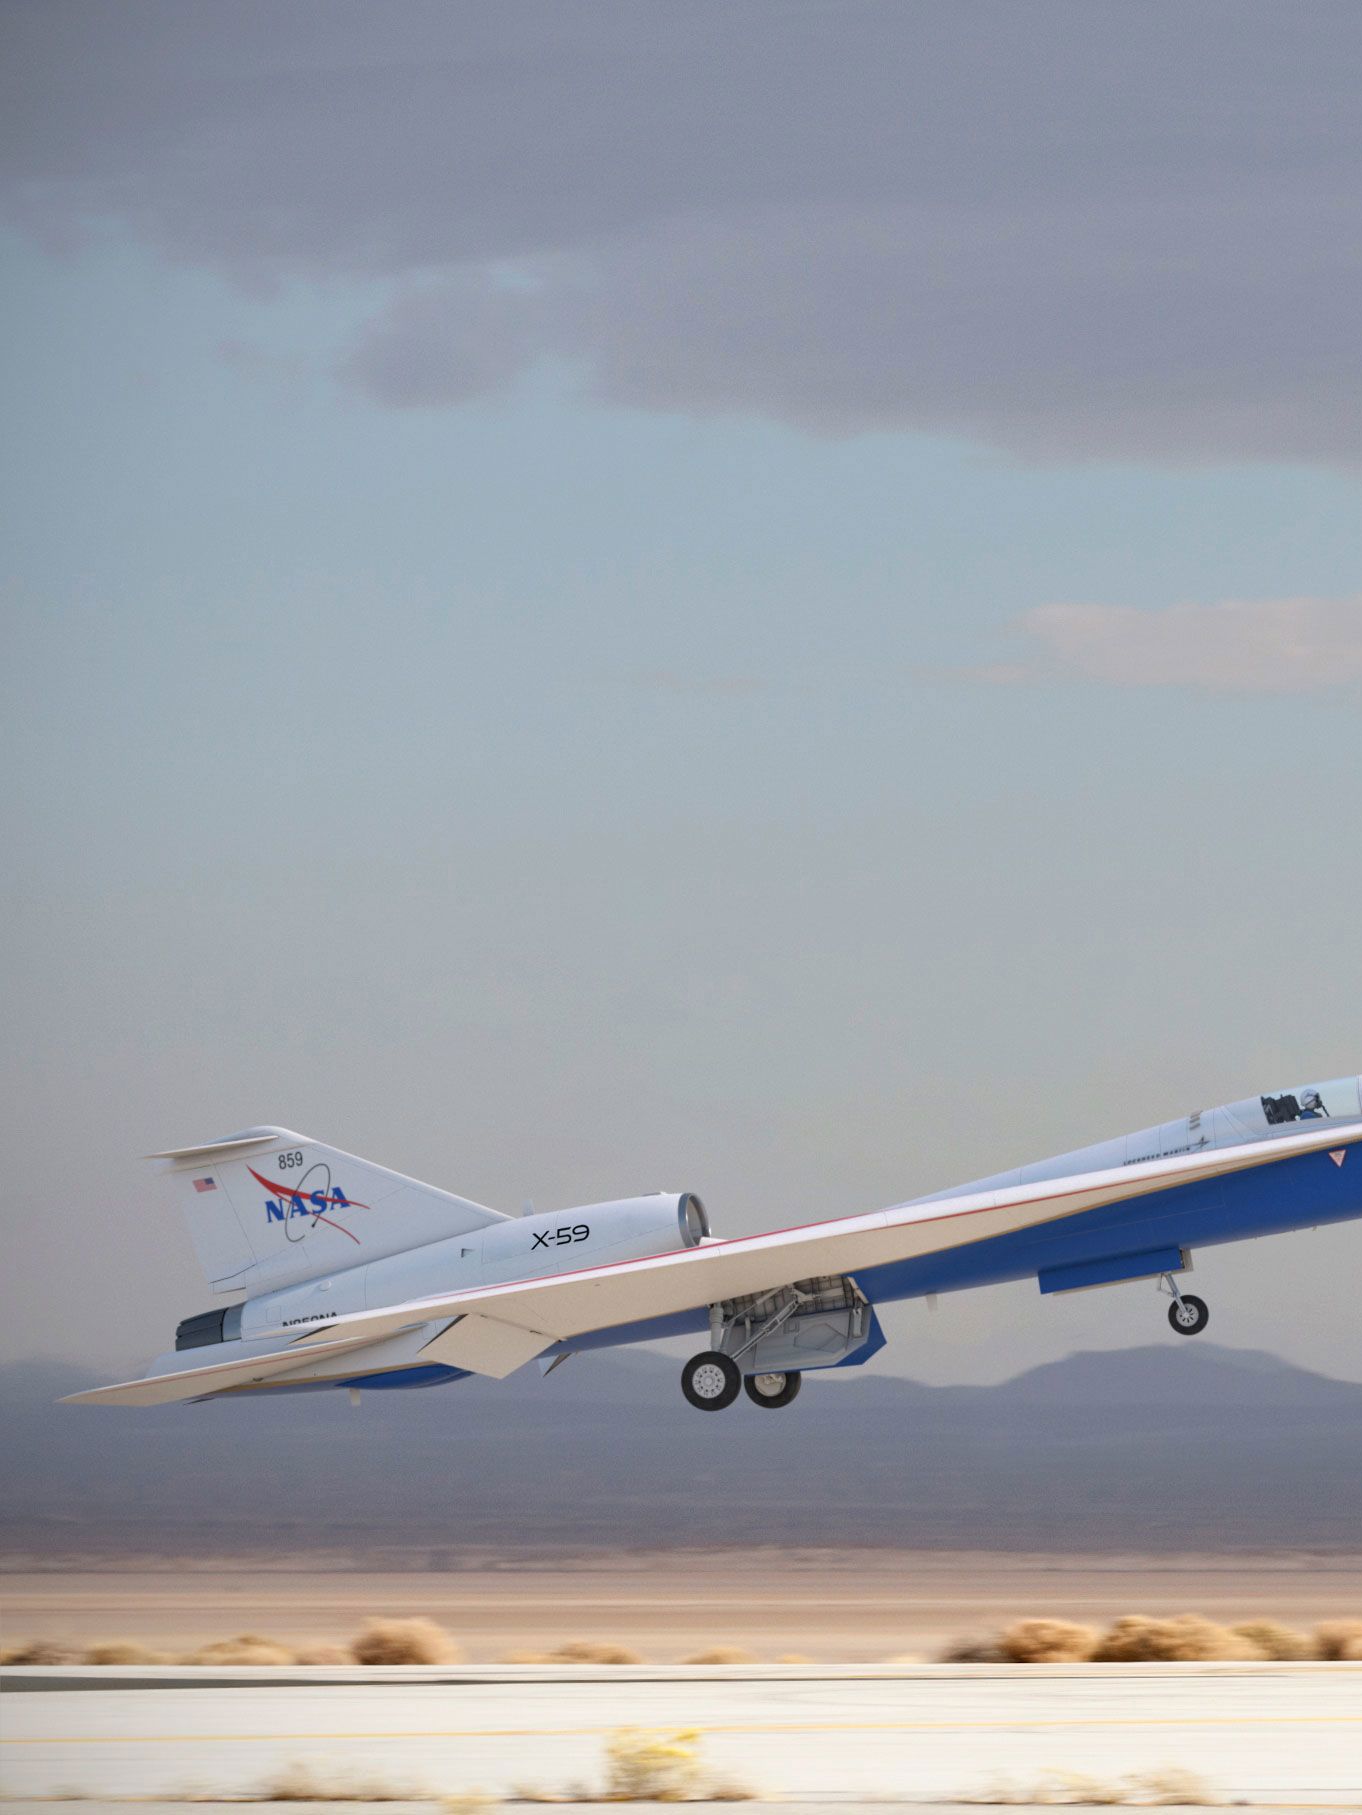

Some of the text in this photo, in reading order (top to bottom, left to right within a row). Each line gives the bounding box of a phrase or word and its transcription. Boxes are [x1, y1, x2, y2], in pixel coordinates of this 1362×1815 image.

[278, 1151, 303, 1170] 859
[265, 1186, 350, 1223] NASA
[531, 1224, 590, 1251] X-59
